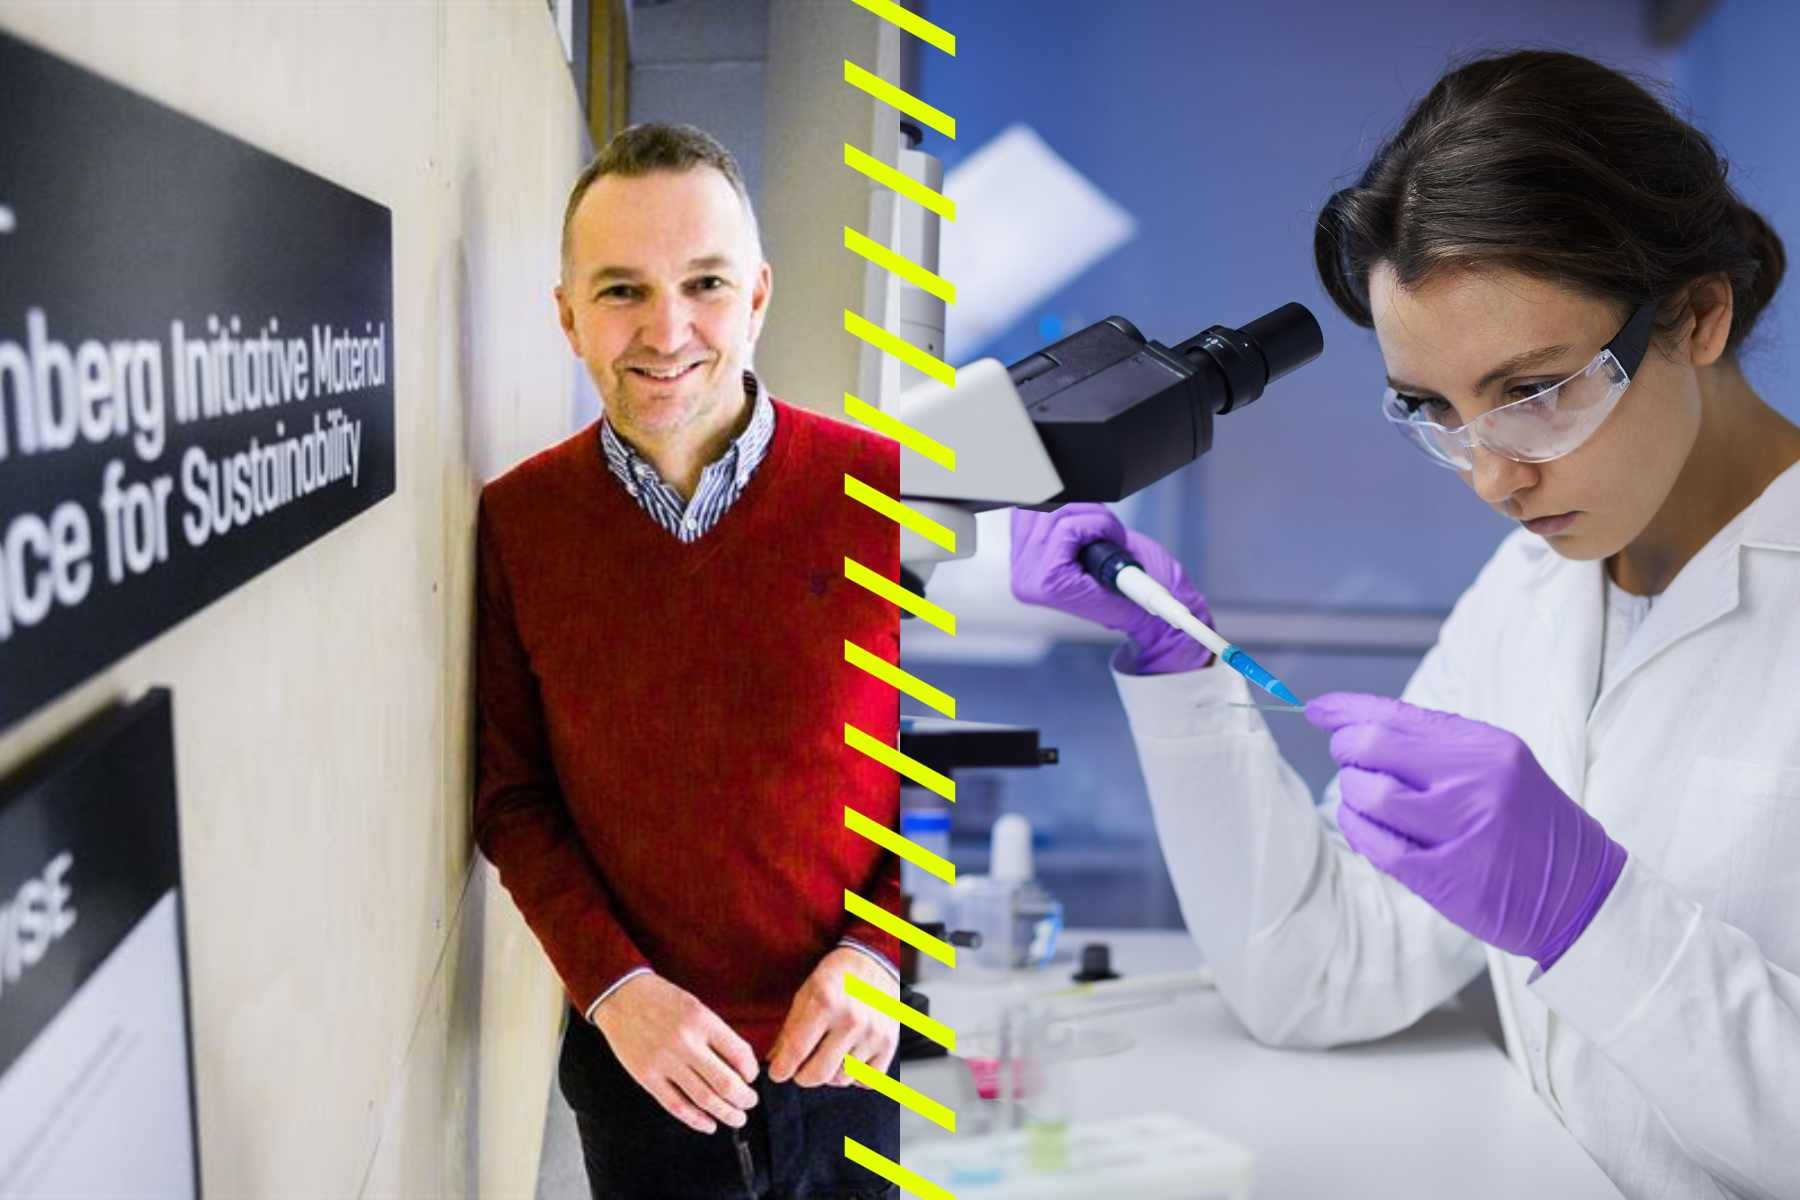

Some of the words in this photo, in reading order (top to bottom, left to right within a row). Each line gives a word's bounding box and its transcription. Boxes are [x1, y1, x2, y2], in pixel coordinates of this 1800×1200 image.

[171, 314, 308, 424] Initiative
[312, 321, 386, 396] Material
[0, 501, 93, 641] ce
[102, 459, 173, 584] for
[182, 407, 361, 546] Sustainability
